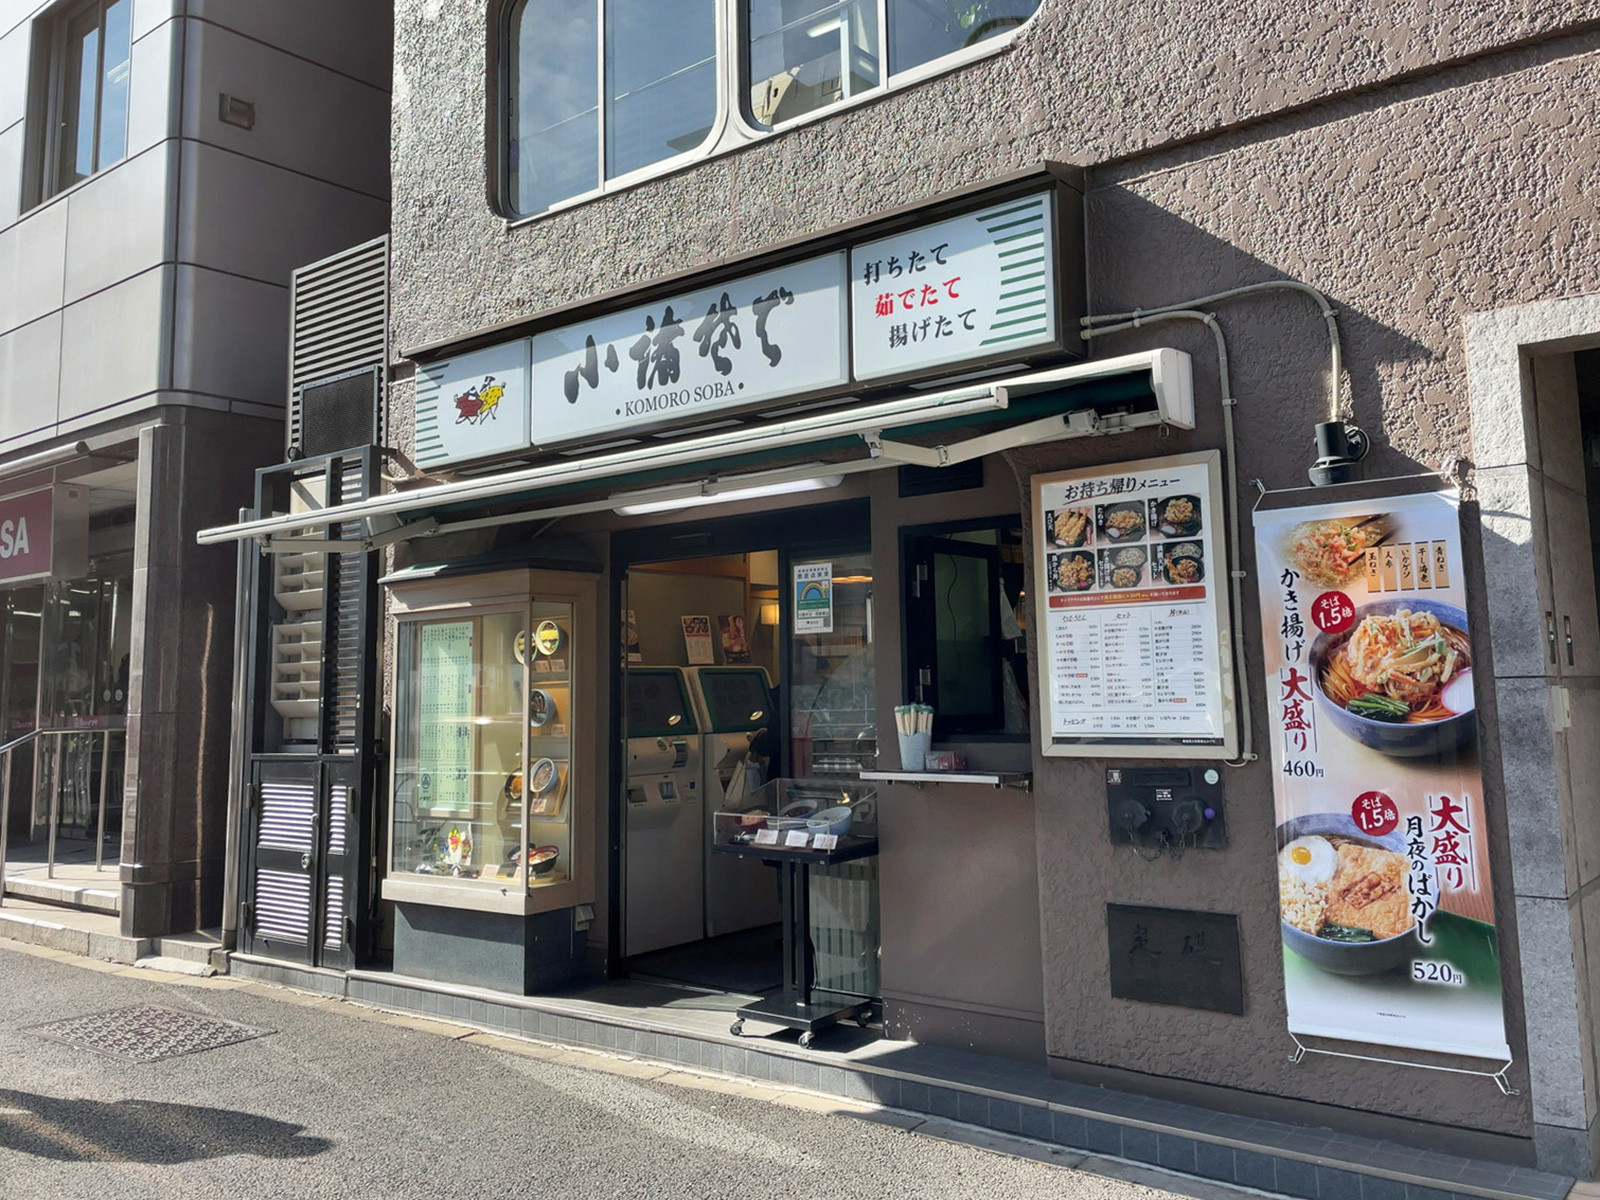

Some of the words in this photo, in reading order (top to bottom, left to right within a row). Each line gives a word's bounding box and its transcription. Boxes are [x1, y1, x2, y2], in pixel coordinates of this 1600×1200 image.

[864, 243, 948, 285] 打ちたて
[875, 277, 961, 318] 茹でたて
[889, 308, 977, 348] 揚げたて
[625, 390, 690, 416] KOMORO
[693, 380, 735, 405] SOBA
[1064, 478, 1181, 500] お持ち帰りメニュー
[0, 516, 29, 559] SA
[1320, 595, 1340, 609] そば
[1319, 606, 1353, 629] 1.5倍
[1283, 759, 1324, 778] 460円
[1361, 796, 1383, 810] そば
[1360, 808, 1396, 830] 1.5倍
[1430, 796, 1470, 889] 大盛り
[1405, 816, 1433, 943] 月夜のばかし
[1413, 962, 1462, 984] 520円
